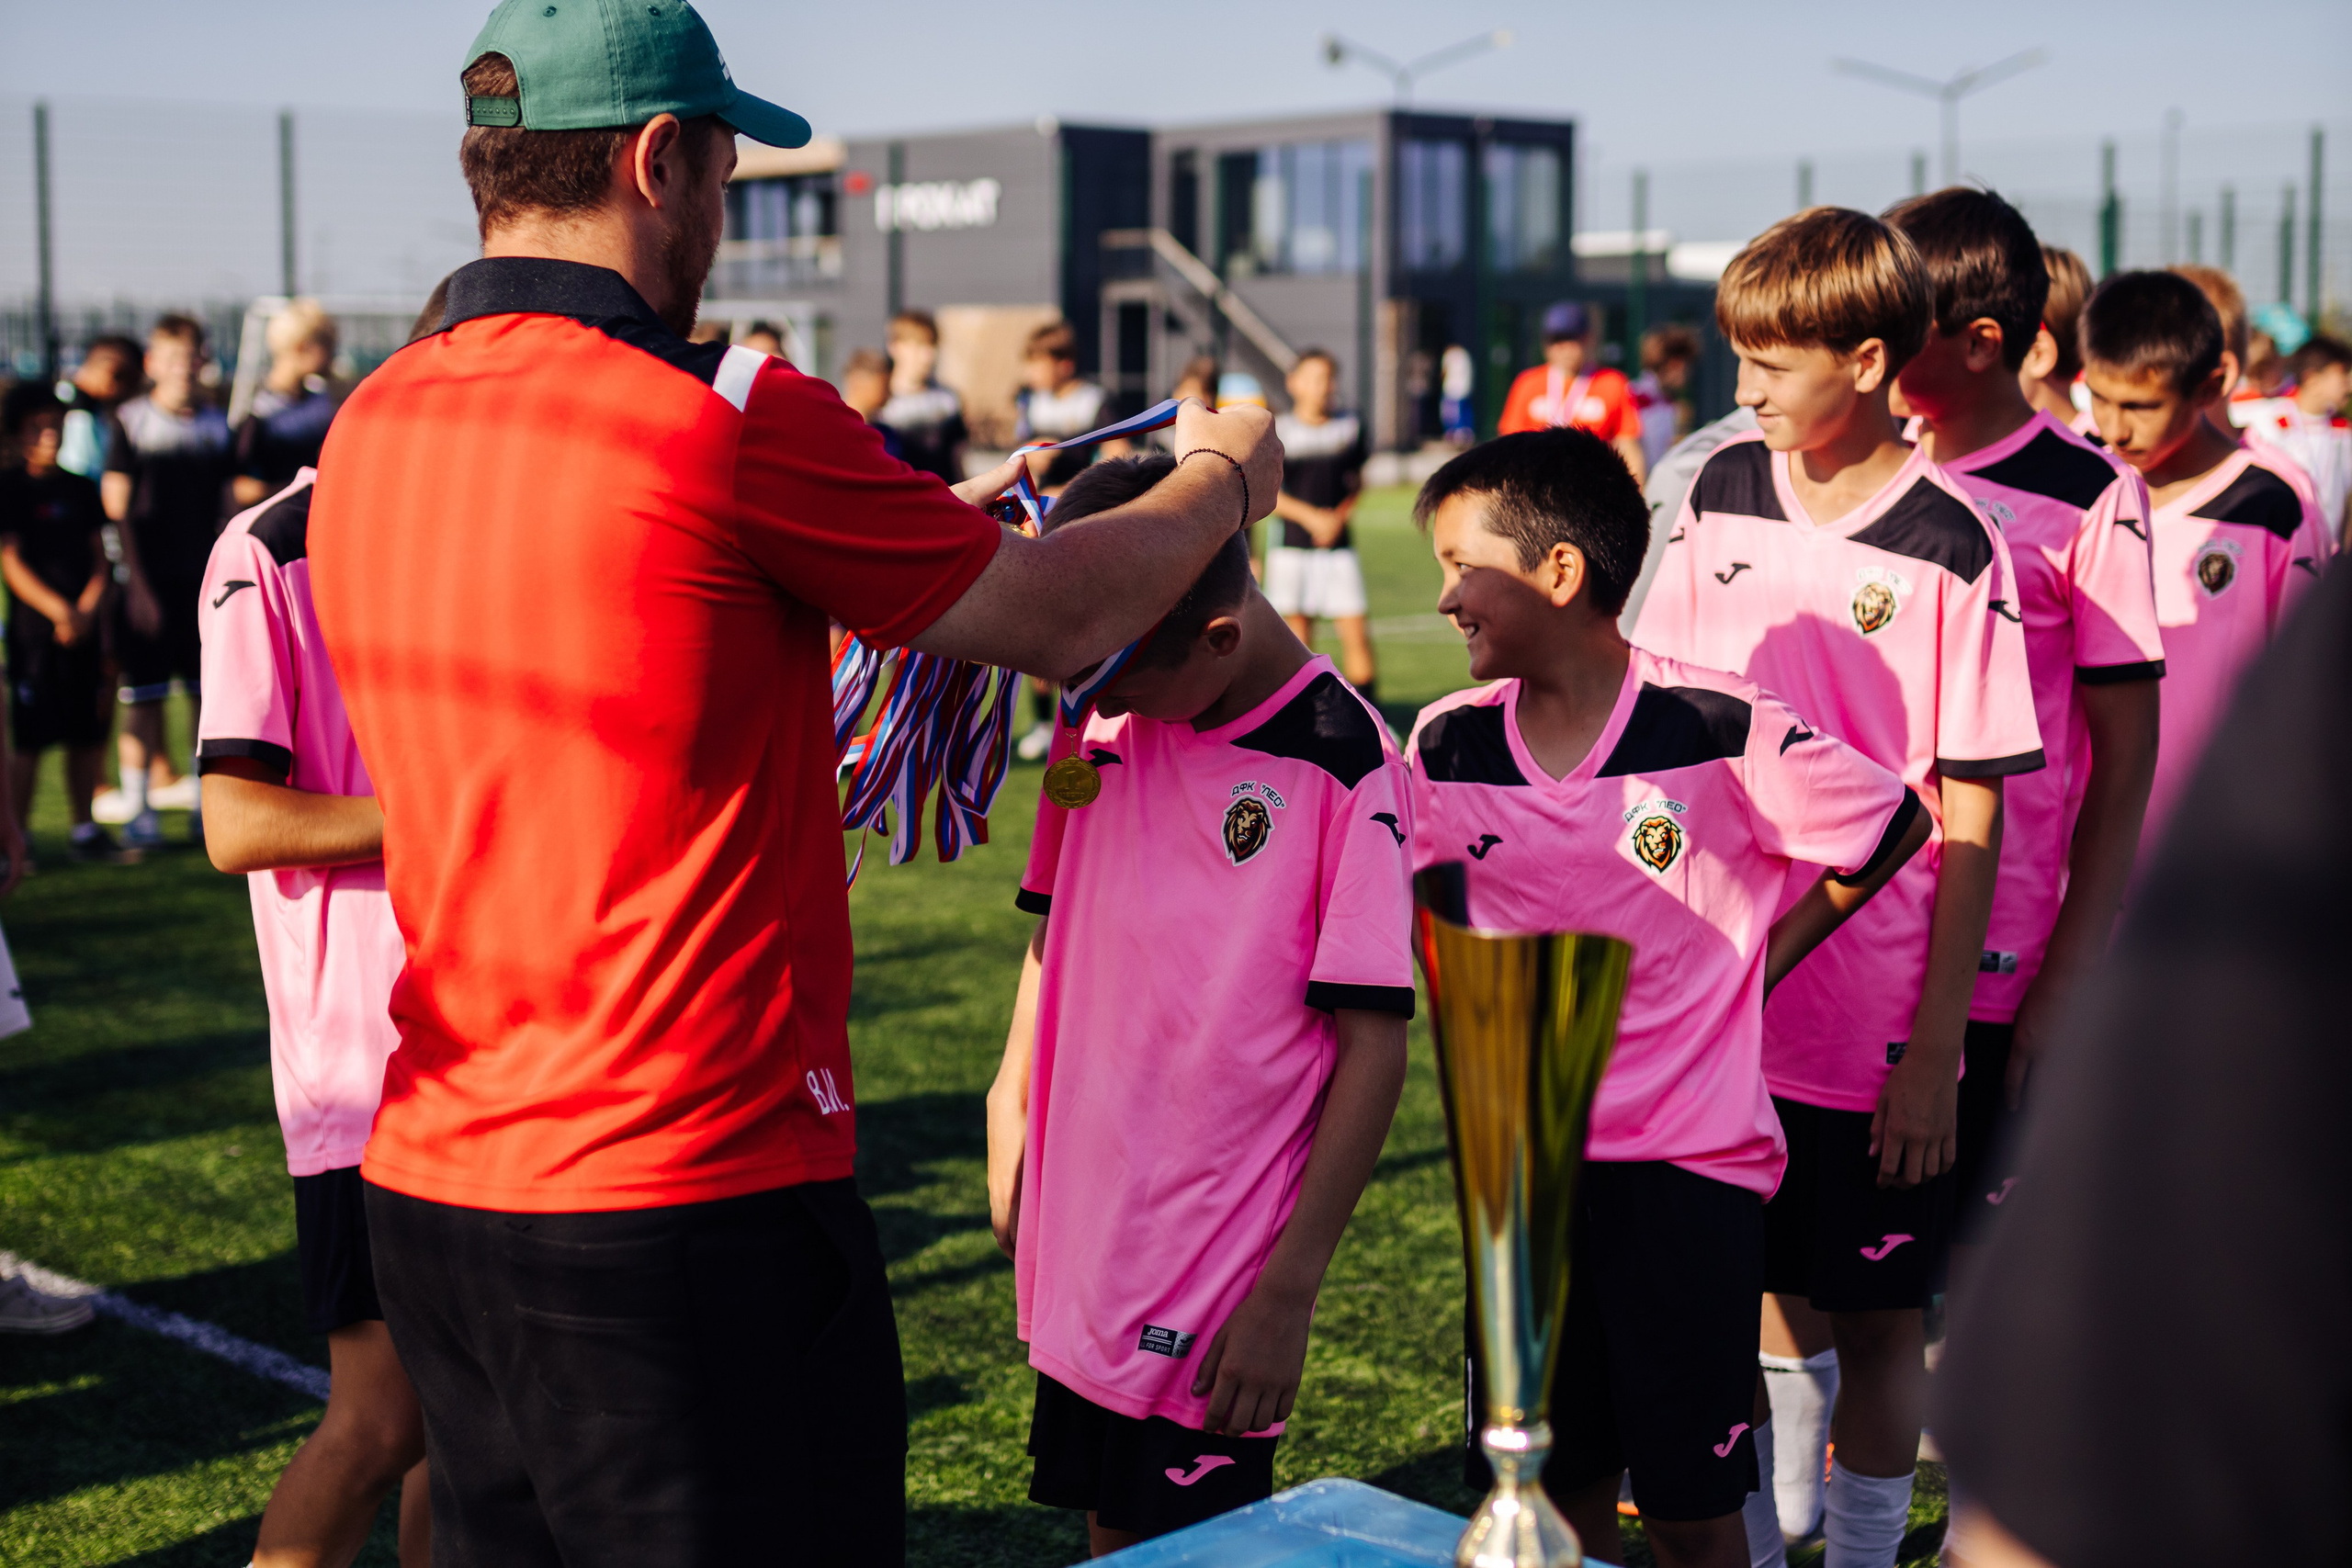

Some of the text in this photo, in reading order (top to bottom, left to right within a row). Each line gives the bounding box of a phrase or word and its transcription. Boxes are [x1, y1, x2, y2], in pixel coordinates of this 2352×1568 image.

[1231, 782, 1256, 797] ДФК
[1623, 802, 1648, 822] ДФК
[1155, 1344, 1170, 1354] SPORT
